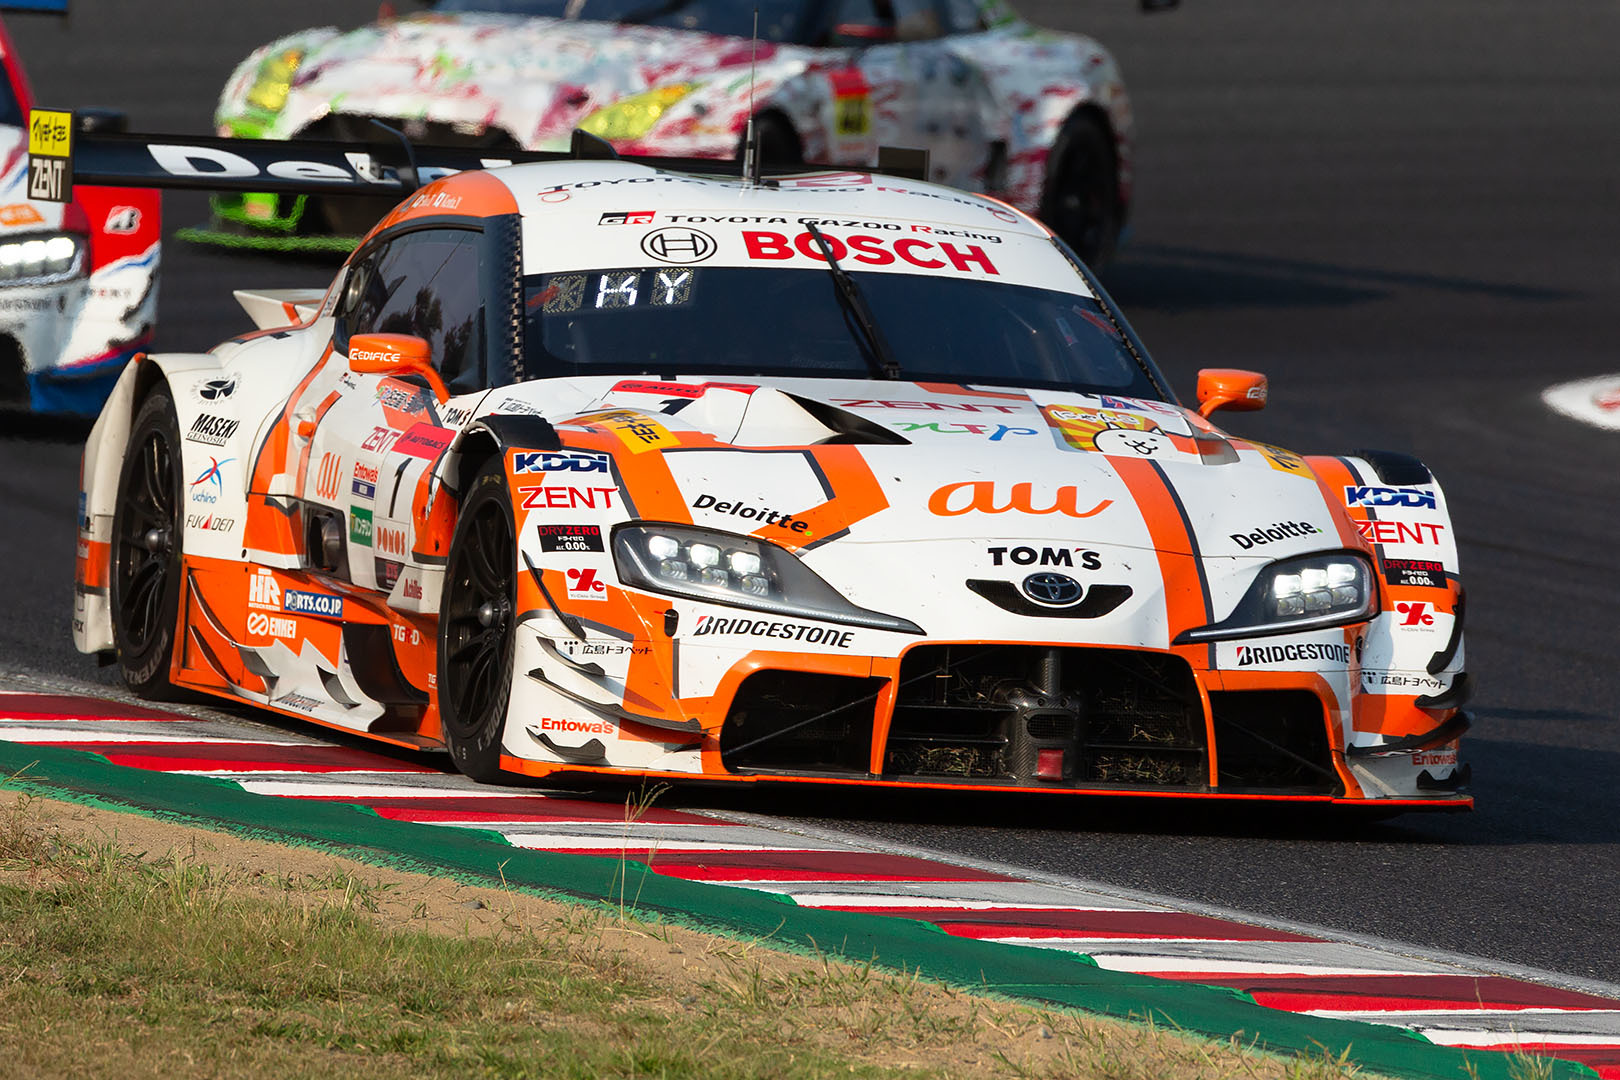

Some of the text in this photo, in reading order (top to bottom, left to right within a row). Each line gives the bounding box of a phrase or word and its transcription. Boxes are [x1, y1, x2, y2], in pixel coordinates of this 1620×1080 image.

[31, 158, 66, 200] ZENT
[600, 212, 1002, 244] GR TOYOTA GAZOO Racing
[741, 231, 1000, 276] BOSCH
[357, 351, 400, 362] EDIFICE
[659, 398, 695, 416] 1
[828, 398, 1022, 414] ZENT
[190, 413, 240, 439] MASEKI
[361, 426, 402, 454] ZENT
[515, 453, 607, 473] KDDI
[316, 451, 343, 501] au
[192, 491, 217, 504] uchino
[388, 458, 413, 518] 1
[520, 487, 618, 509] ZENT
[928, 480, 1114, 518] au
[1347, 487, 1436, 510] KDDI
[377, 526, 406, 556] PONOS
[1354, 521, 1444, 545] ZENT
[987, 546, 1102, 570] TOM'S
[269, 617, 297, 639] ENKEI
[693, 616, 855, 648] BRIDGESTONE
[582, 644, 653, 655] 広島トヨペット
[1237, 644, 1350, 667] BRIDGESTONE
[1381, 675, 1447, 689] 広島トヨペット
[541, 717, 614, 734] Entowa's
